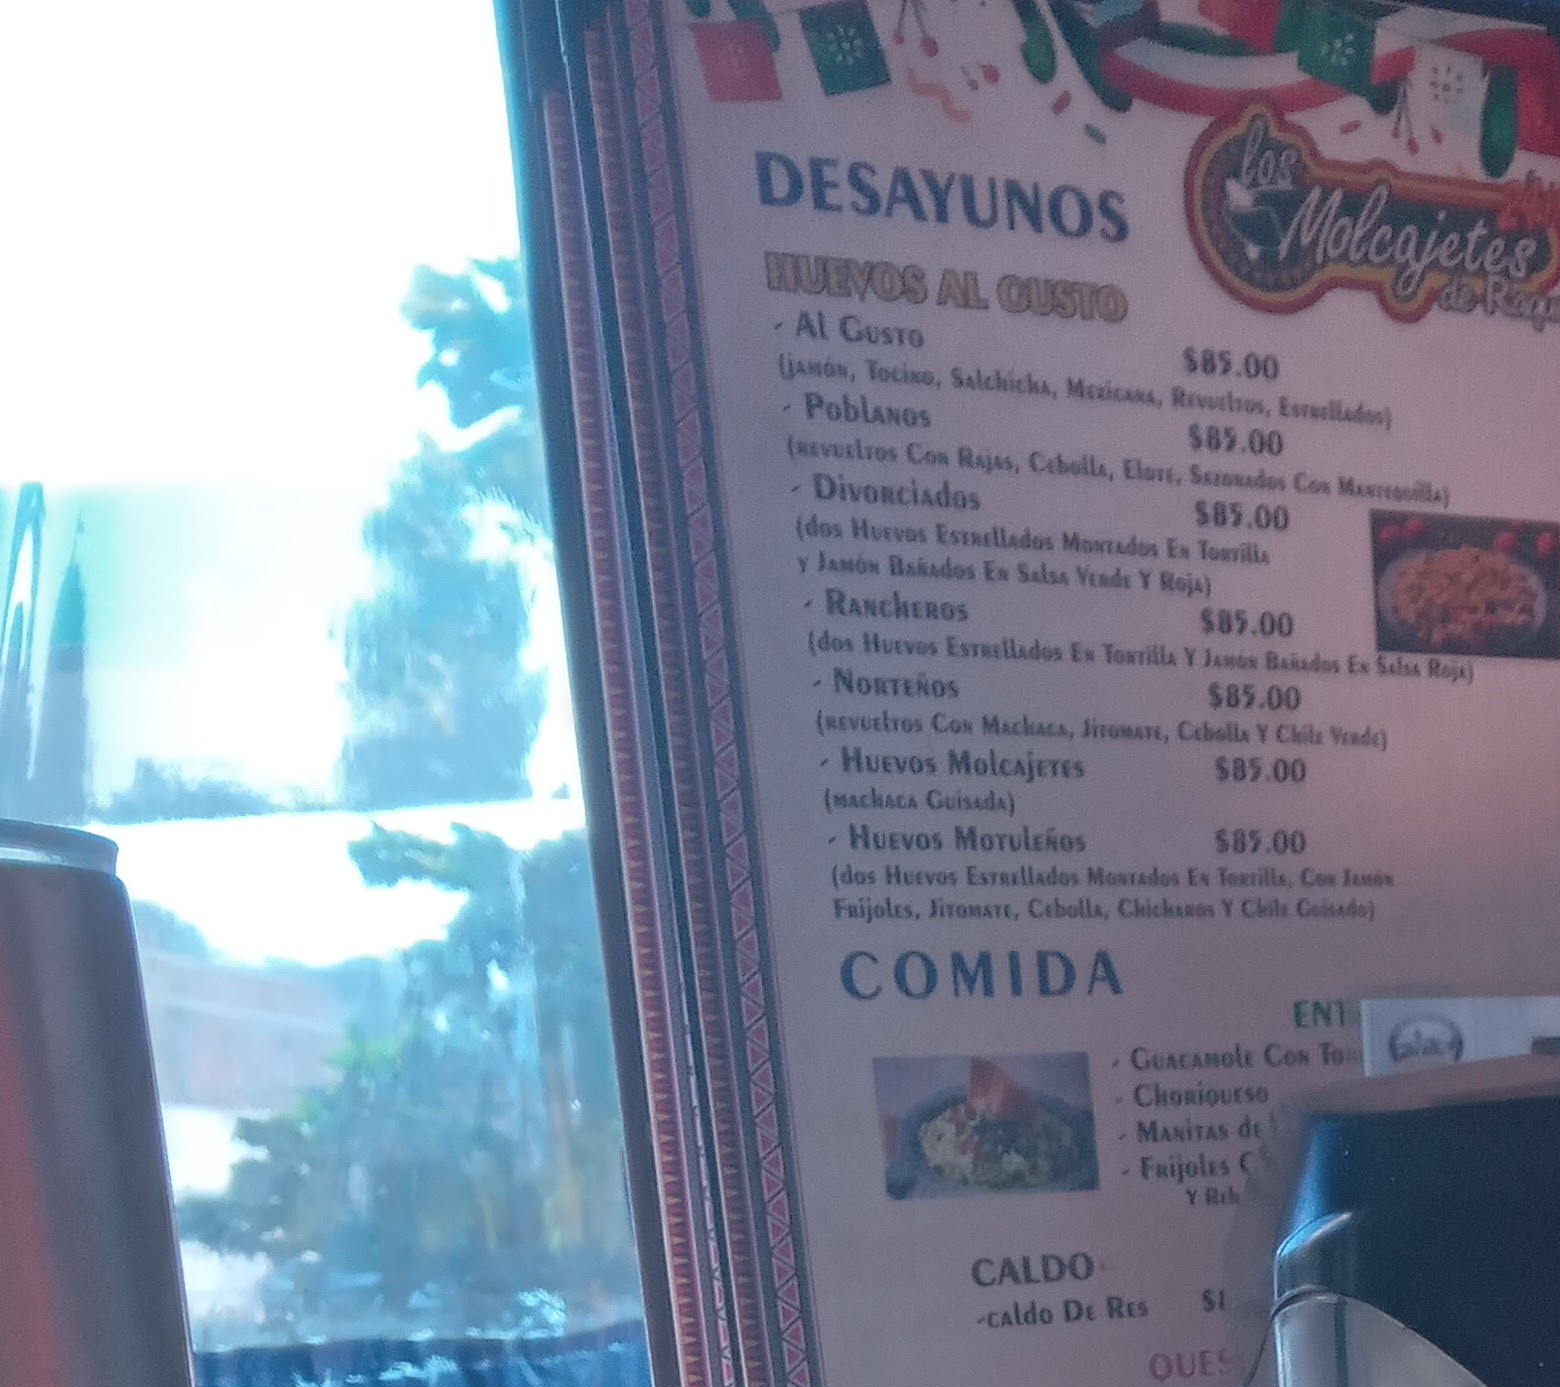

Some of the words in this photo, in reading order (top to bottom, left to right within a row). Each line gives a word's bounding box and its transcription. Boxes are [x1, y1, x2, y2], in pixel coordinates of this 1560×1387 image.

[755, 151, 1129, 242] DESAYUNOS
[1278, 179, 1539, 294] Molcajetes
[764, 251, 928, 305] HUEVOS
[936, 268, 990, 311] AL
[996, 274, 1129, 325] GUSTO
[1183, 346, 1280, 382] $85.00
[1188, 423, 1284, 457] $85.00
[1195, 499, 1290, 532] $85.00
[1200, 607, 1294, 639] $85.00
[1208, 682, 1301, 712] $85.00
[841, 745, 937, 775] Huevos
[948, 749, 1085, 783] Molcajetes
[1215, 755, 1307, 785] $85.00
[849, 823, 943, 852] Huevos
[954, 825, 1086, 854] Motuleños
[1215, 828, 1307, 856] $85.00
[840, 949, 1122, 1001] COMIDA
[971, 1252, 1094, 1288] CALDO
